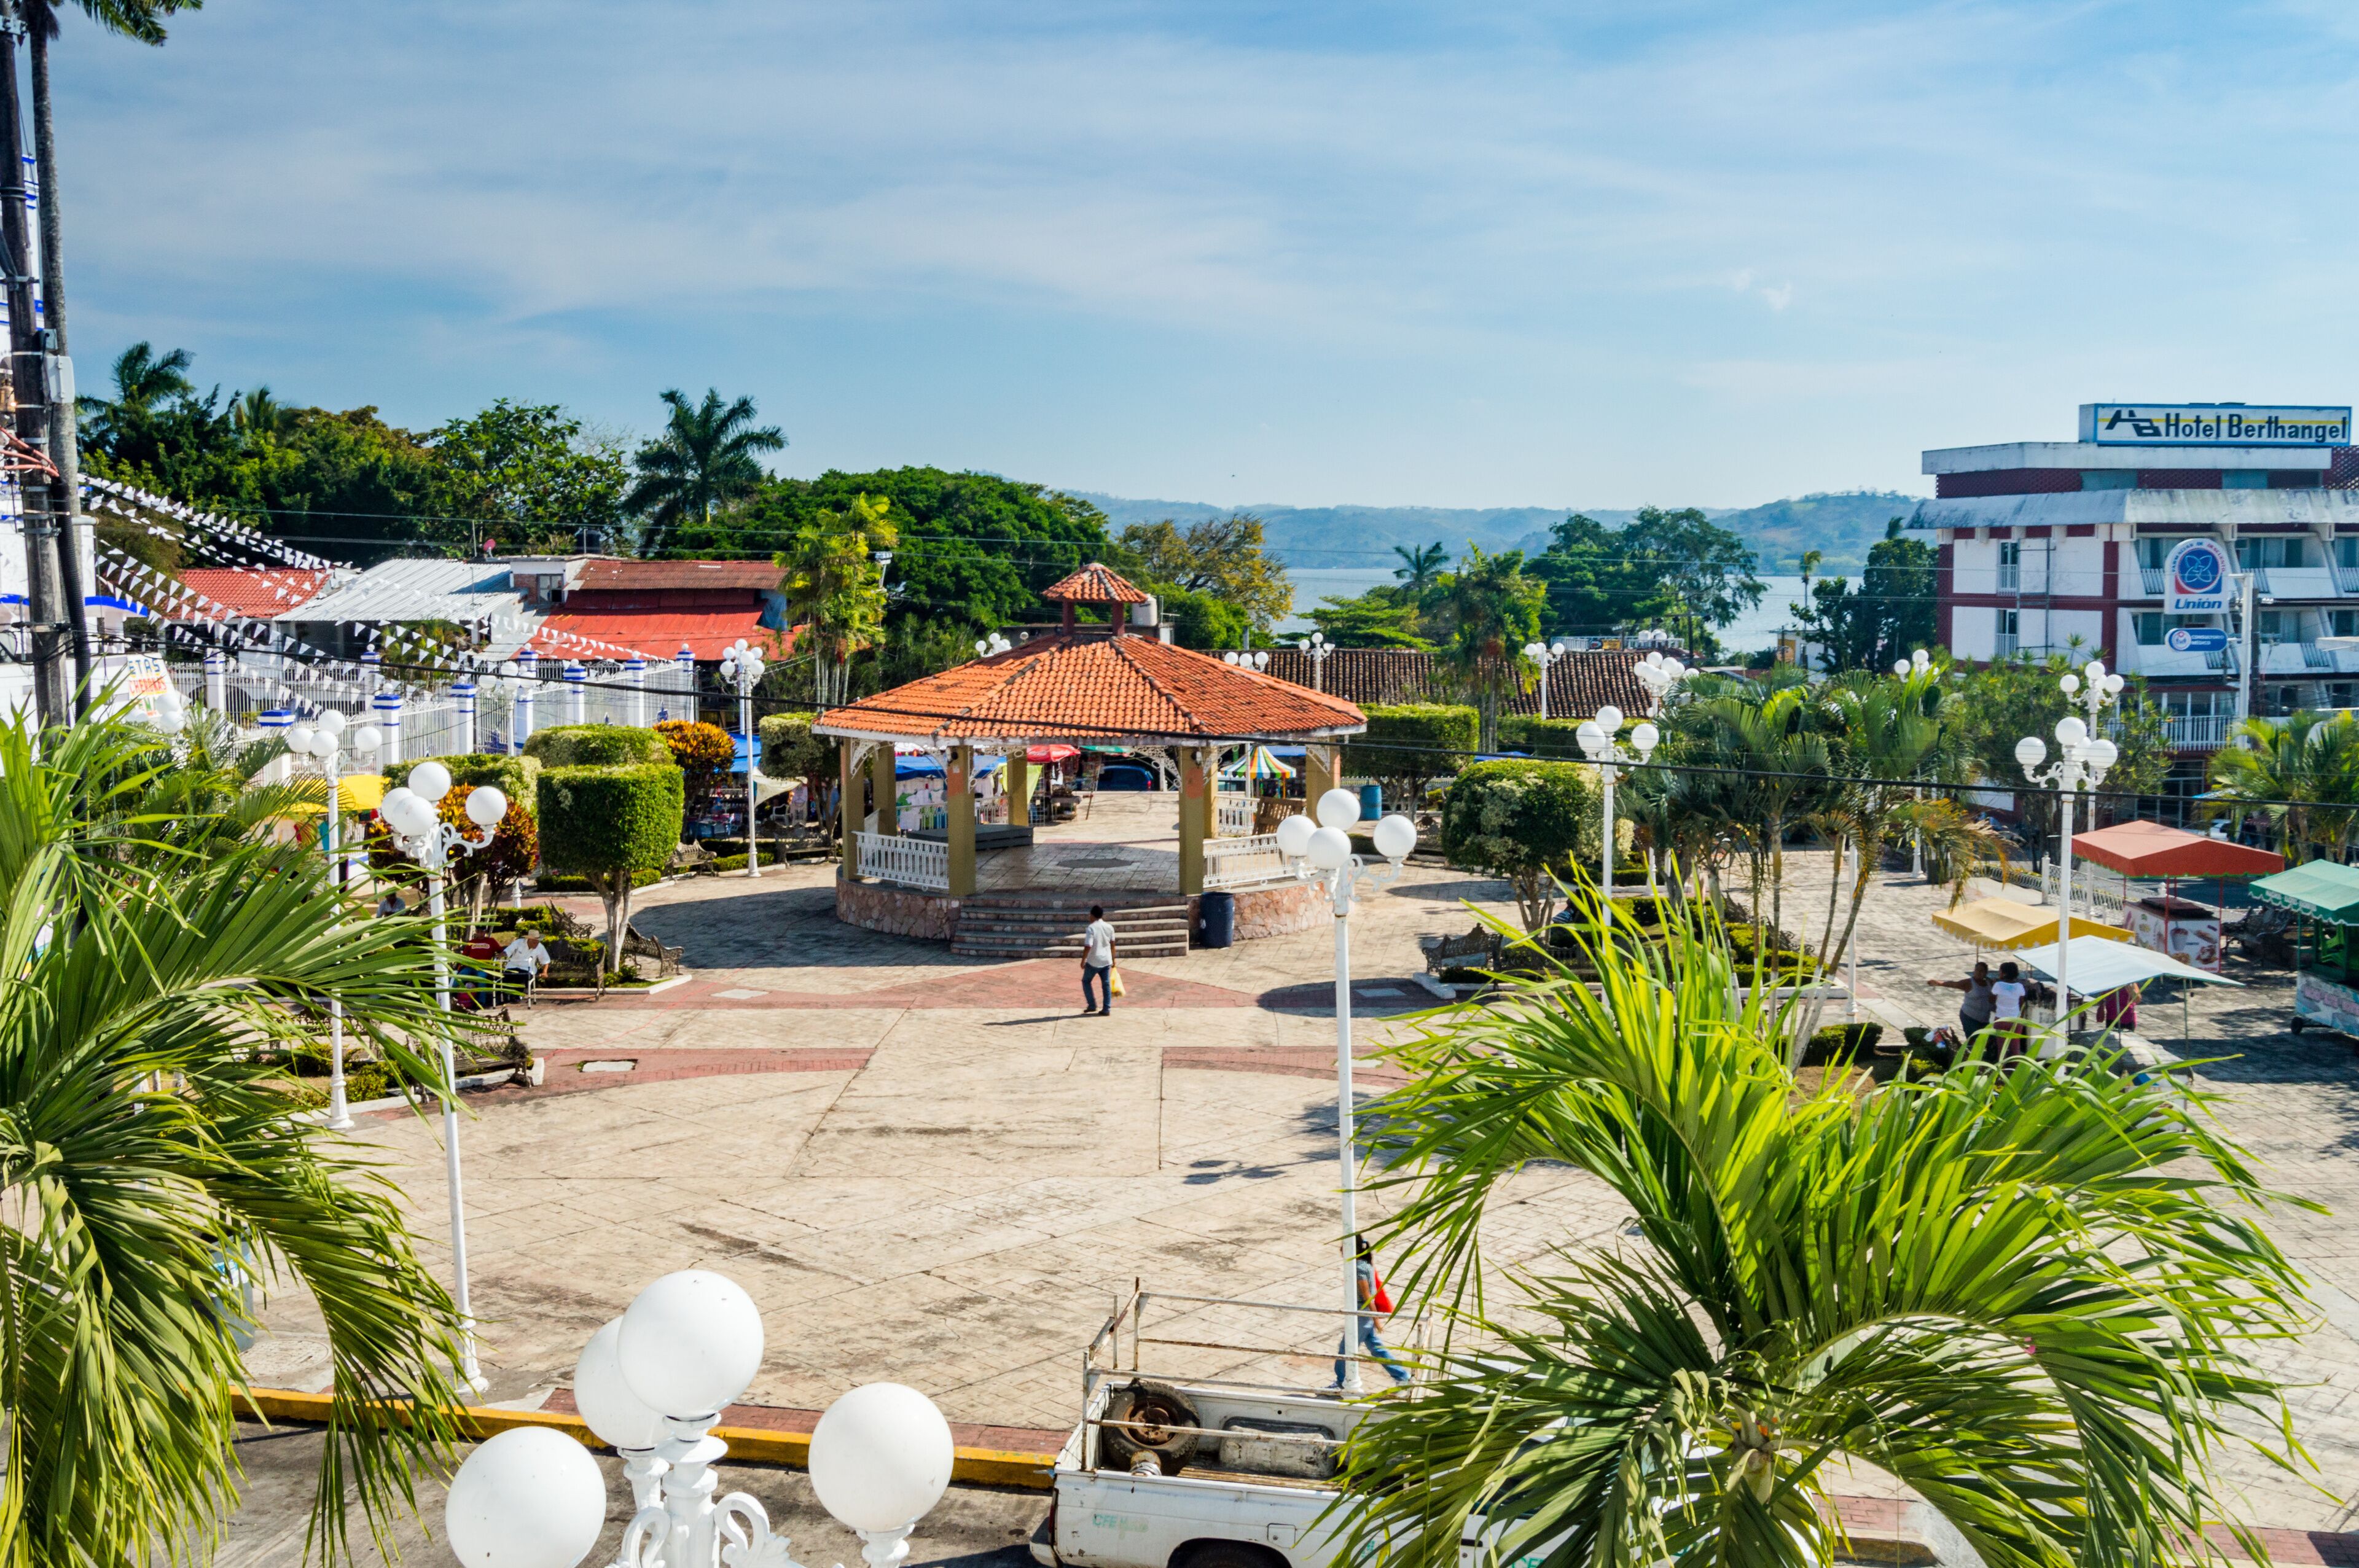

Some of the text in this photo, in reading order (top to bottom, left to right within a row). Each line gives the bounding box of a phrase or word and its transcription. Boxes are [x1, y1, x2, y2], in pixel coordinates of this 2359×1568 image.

[2165, 413, 2221, 439] Hotel
[2228, 413, 2347, 443] Berthangel
[2175, 598, 2223, 609] Unión
